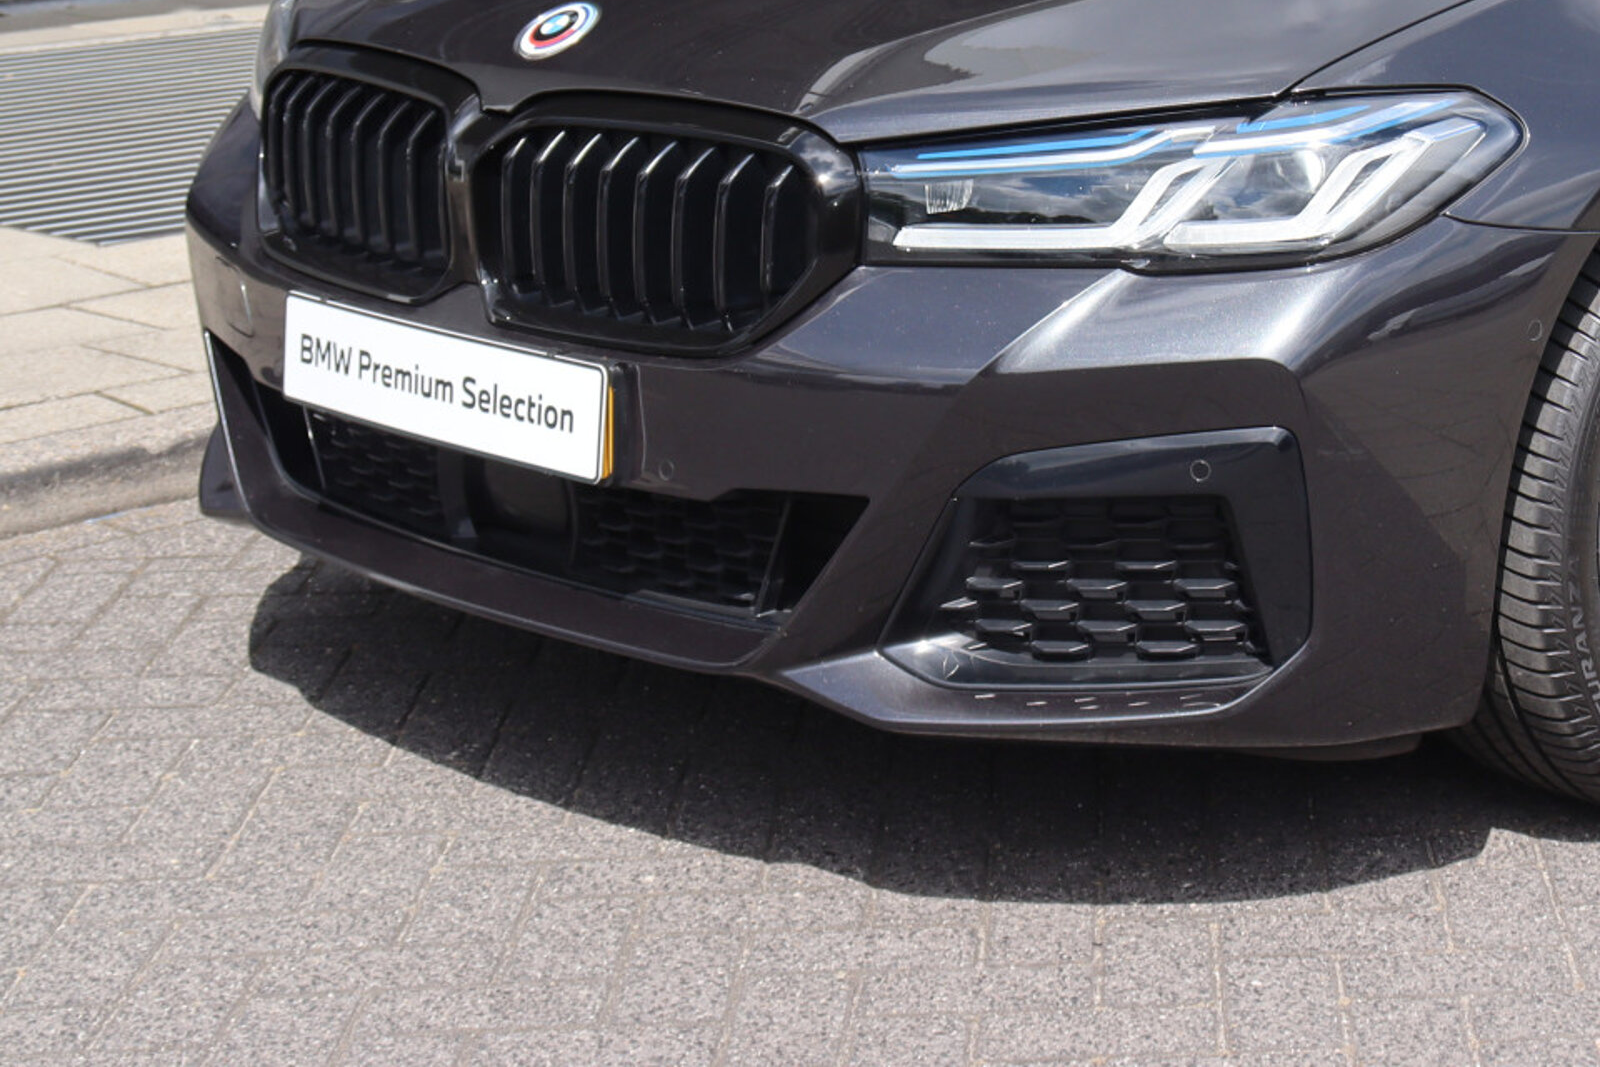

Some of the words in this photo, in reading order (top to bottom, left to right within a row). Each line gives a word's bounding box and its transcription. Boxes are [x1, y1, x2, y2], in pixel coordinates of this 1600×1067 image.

[299, 333, 353, 377] BMW
[357, 349, 455, 405] Premium
[461, 376, 575, 434] Selection
